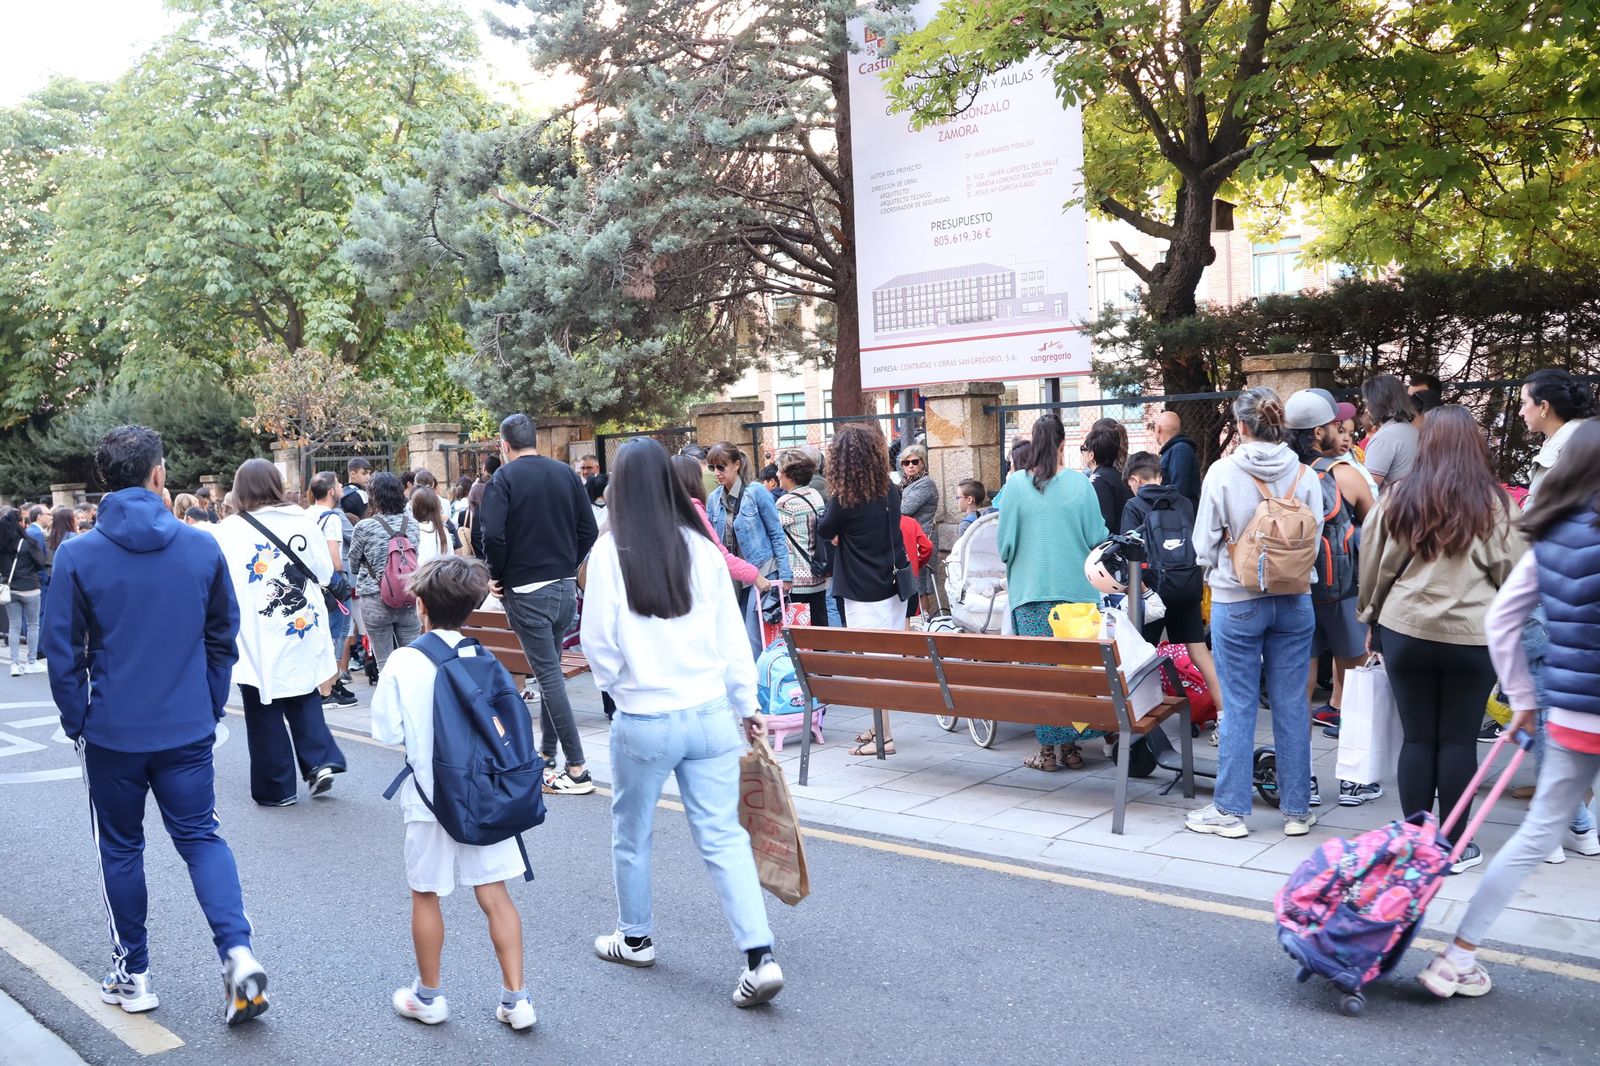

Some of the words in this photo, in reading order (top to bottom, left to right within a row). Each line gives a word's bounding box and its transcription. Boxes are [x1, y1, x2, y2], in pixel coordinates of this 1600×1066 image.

[991, 77, 998, 89] Y
[1000, 69, 1034, 87] AULAS
[960, 99, 1010, 121] GONZALO
[938, 124, 979, 142] ZAMORA
[886, 169, 895, 177] DEL
[896, 163, 922, 173] PROYECTO
[1042, 157, 1058, 166] VALLE
[896, 180, 903, 188] DE
[880, 196, 909, 207] ARQUITECTO
[930, 211, 993, 232] PRESUPUESTO
[933, 230, 983, 247] 805.619,36
[985, 227, 992, 238] €
[873, 365, 899, 374] EMPRESA:
[900, 361, 932, 371] CONTRATAS
[938, 358, 957, 367] OBRAS
[958, 357, 970, 366] SAN
[1030, 352, 1072, 363] sangregorio
